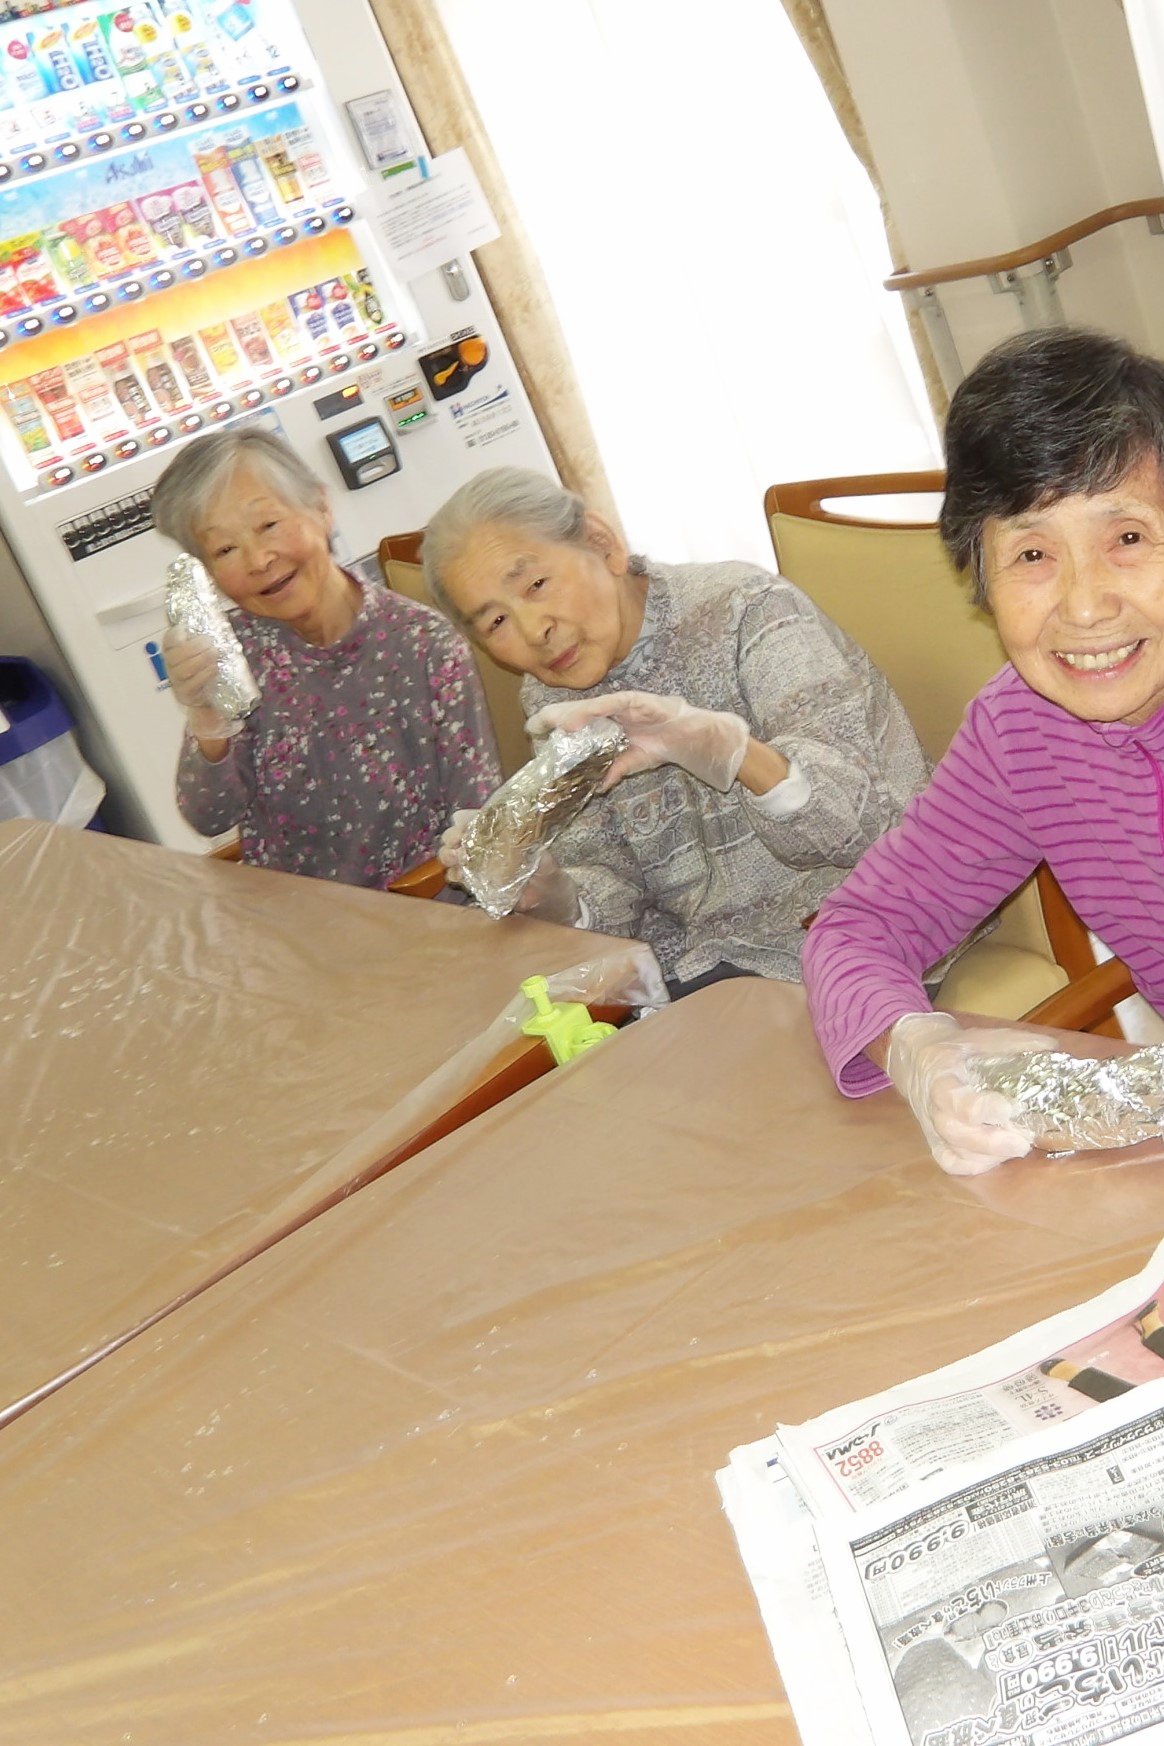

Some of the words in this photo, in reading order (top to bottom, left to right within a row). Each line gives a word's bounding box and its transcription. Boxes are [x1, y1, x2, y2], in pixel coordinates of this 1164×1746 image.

[102, 150, 154, 183] Asahi
[834, 1439, 885, 1478] 8852
[1082, 1423, 1155, 1459] サンケイツアーズ
[972, 1498, 1036, 1531] 消費者応援価格!
[871, 1521, 967, 1577] 9,990円
[1004, 1645, 1098, 1691] 9,990円
